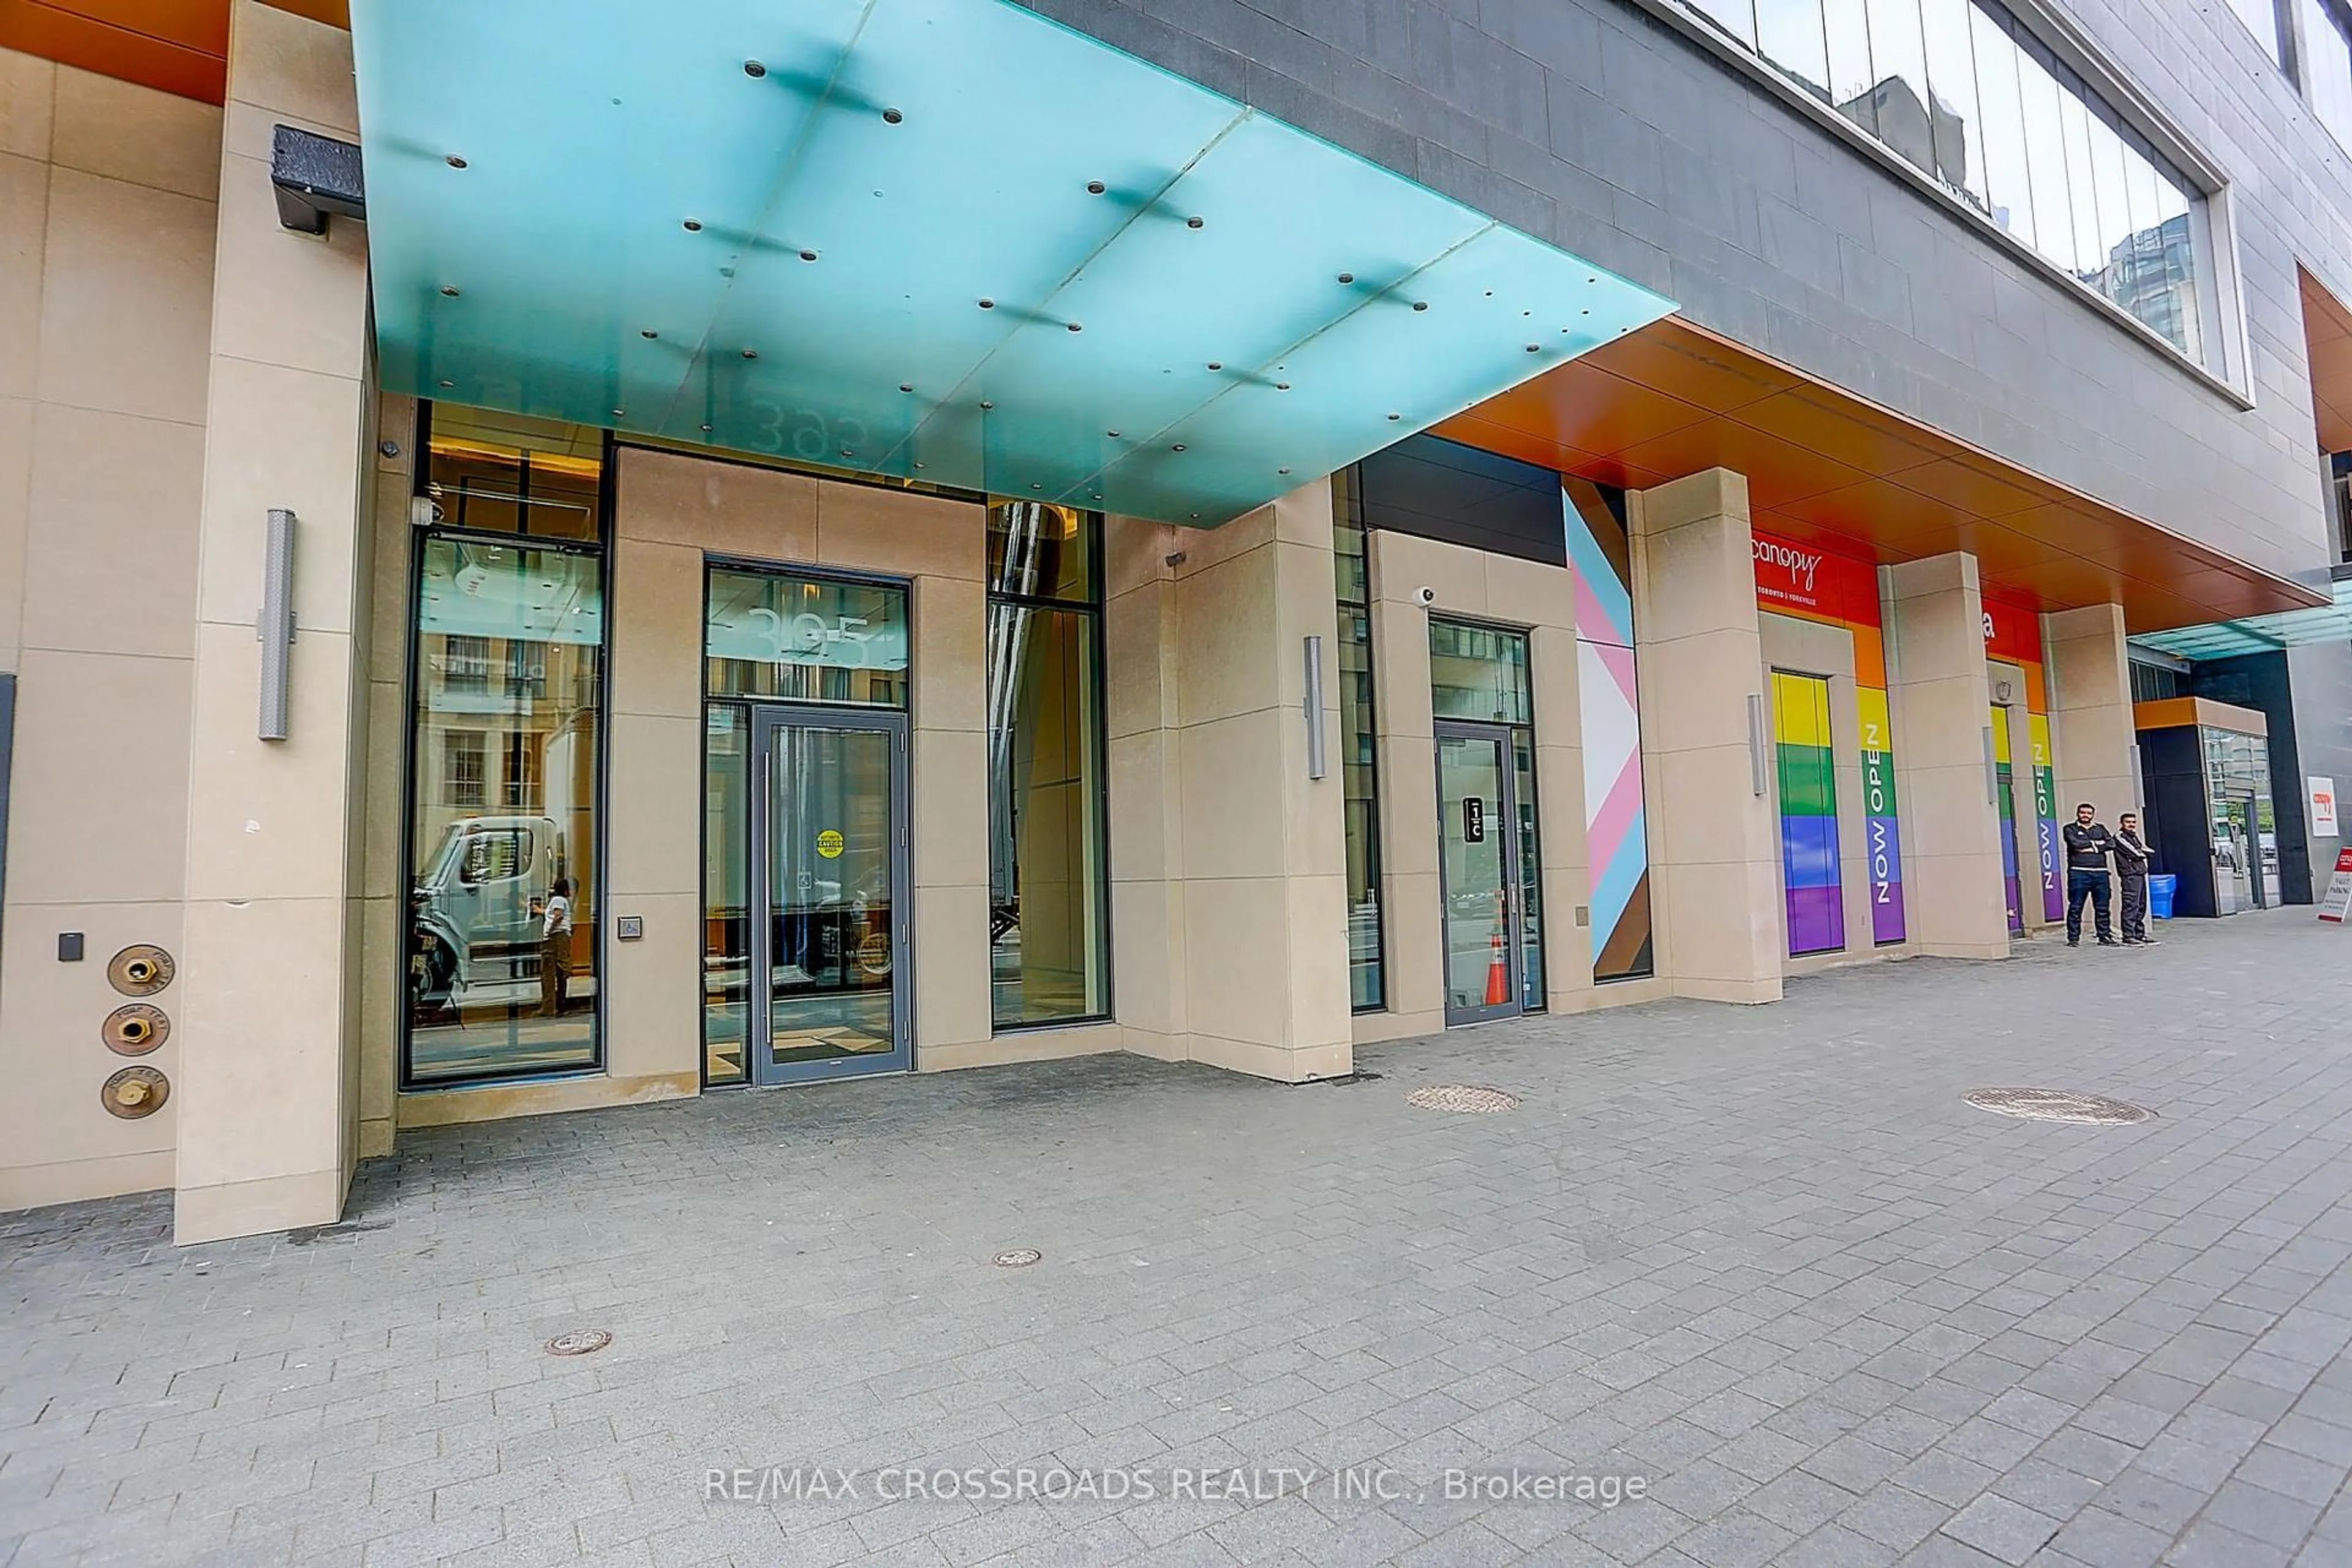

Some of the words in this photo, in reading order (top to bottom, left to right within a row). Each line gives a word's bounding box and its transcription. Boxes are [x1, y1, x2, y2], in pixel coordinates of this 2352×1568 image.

[1751, 538, 1822, 592] canopy
[1866, 723, 1884, 813] OPEN
[2033, 744, 2048, 816] OPEN
[1872, 821, 1890, 903] NOW
[2040, 822, 2054, 889] NOW
